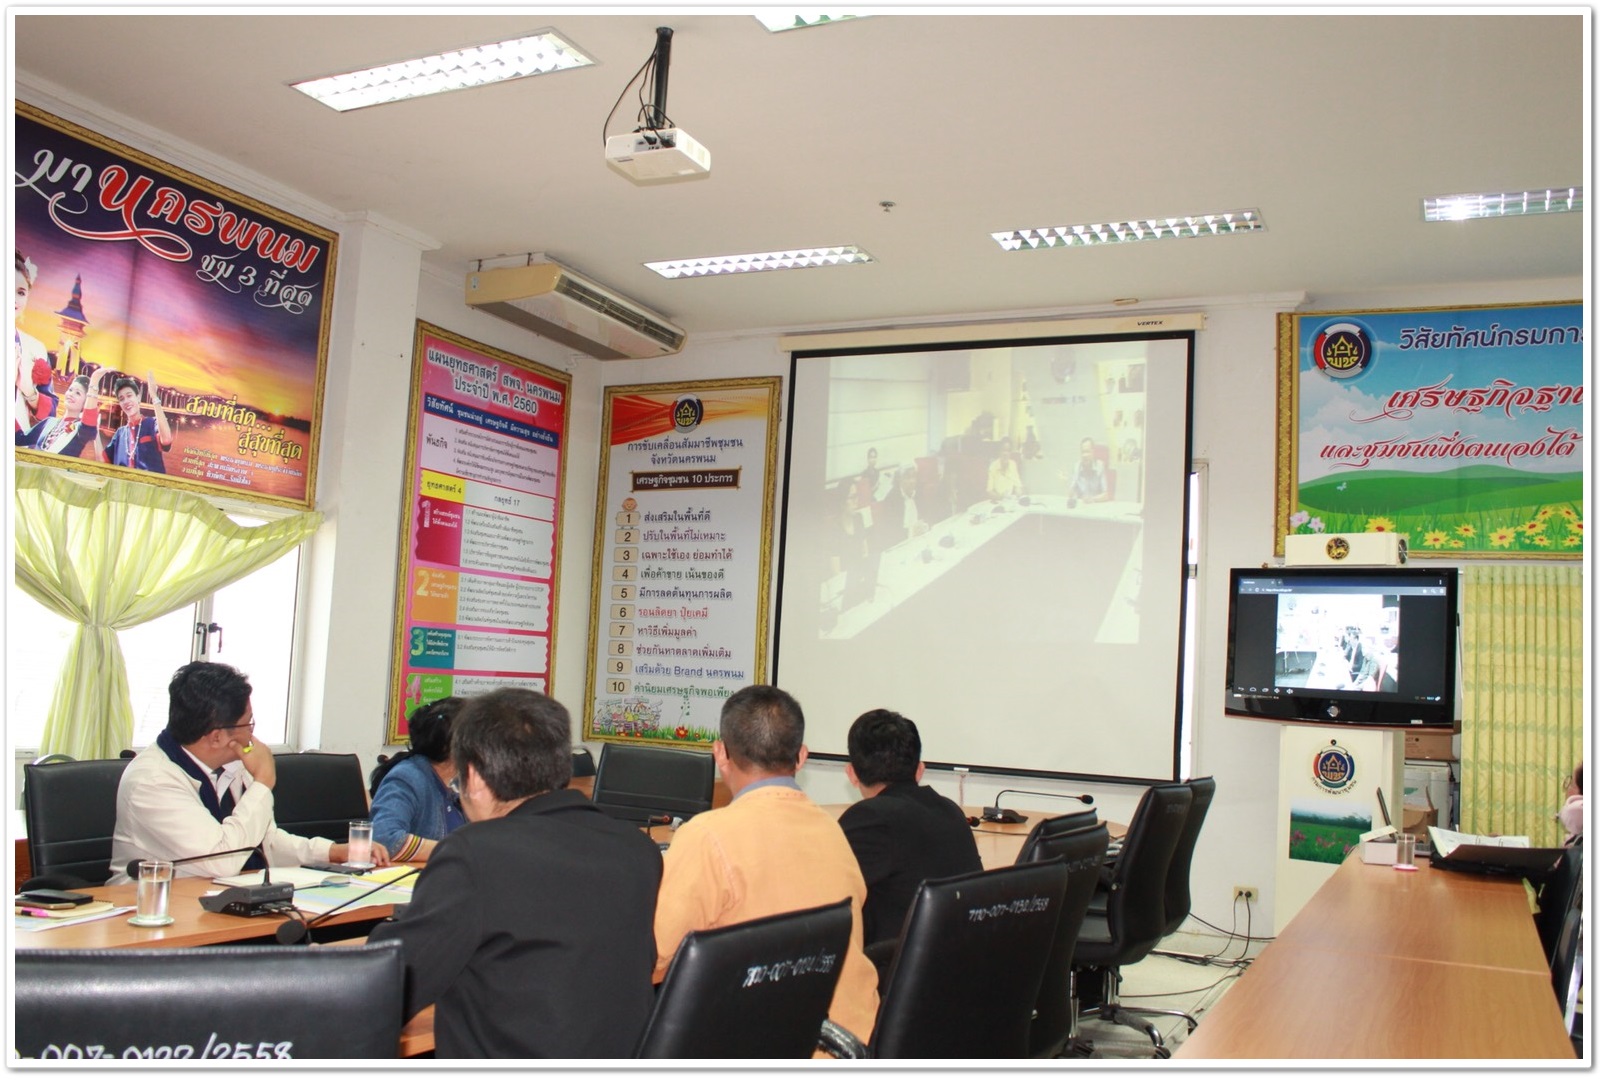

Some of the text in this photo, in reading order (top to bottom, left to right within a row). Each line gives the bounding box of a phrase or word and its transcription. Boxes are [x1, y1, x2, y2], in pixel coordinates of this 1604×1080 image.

[20, 149, 321, 273] มา นครพนม
[197, 251, 319, 314] ชม 3 ที่สุด
[1400, 324, 1583, 350] วิสัยทัศน์กรมกา
[428, 349, 561, 404] แผนยุทธศาสตร์ สพจ. นครพนม
[454, 377, 538, 414] ประจำปี พ.ศ. 2560
[627, 435, 743, 452] การขับเคลื่อนสัมมาชีพชุมชน
[651, 453, 716, 466] จังหวัดนครพนม
[636, 473, 733, 487] เศรษฐกิจชุมชน 10 ประการ
[421, 500, 431, 528] 1
[644, 507, 711, 523] ส่งเสริมในพื้นที่ดี
[624, 532, 631, 542] 2
[622, 548, 733, 562] 3 เฉพาะใช้เอง ย่อมทำได้
[621, 569, 629, 579] 4
[685, 567, 725, 580] เน้นของดี
[416, 570, 430, 597] 2
[620, 586, 732, 601] 5 มีการลดต้นทุนการผลิต
[619, 607, 627, 617] 6
[618, 623, 697, 639] 7 หาวิธีเพิ่มมูลค่า
[410, 628, 424, 656] 3
[617, 643, 731, 658] 8 ช่วยกันหาตลาดเพิ่มเติม
[616, 662, 744, 678] 9 เสริมด้วย Brand นครพนม
[612, 681, 625, 692] 10
